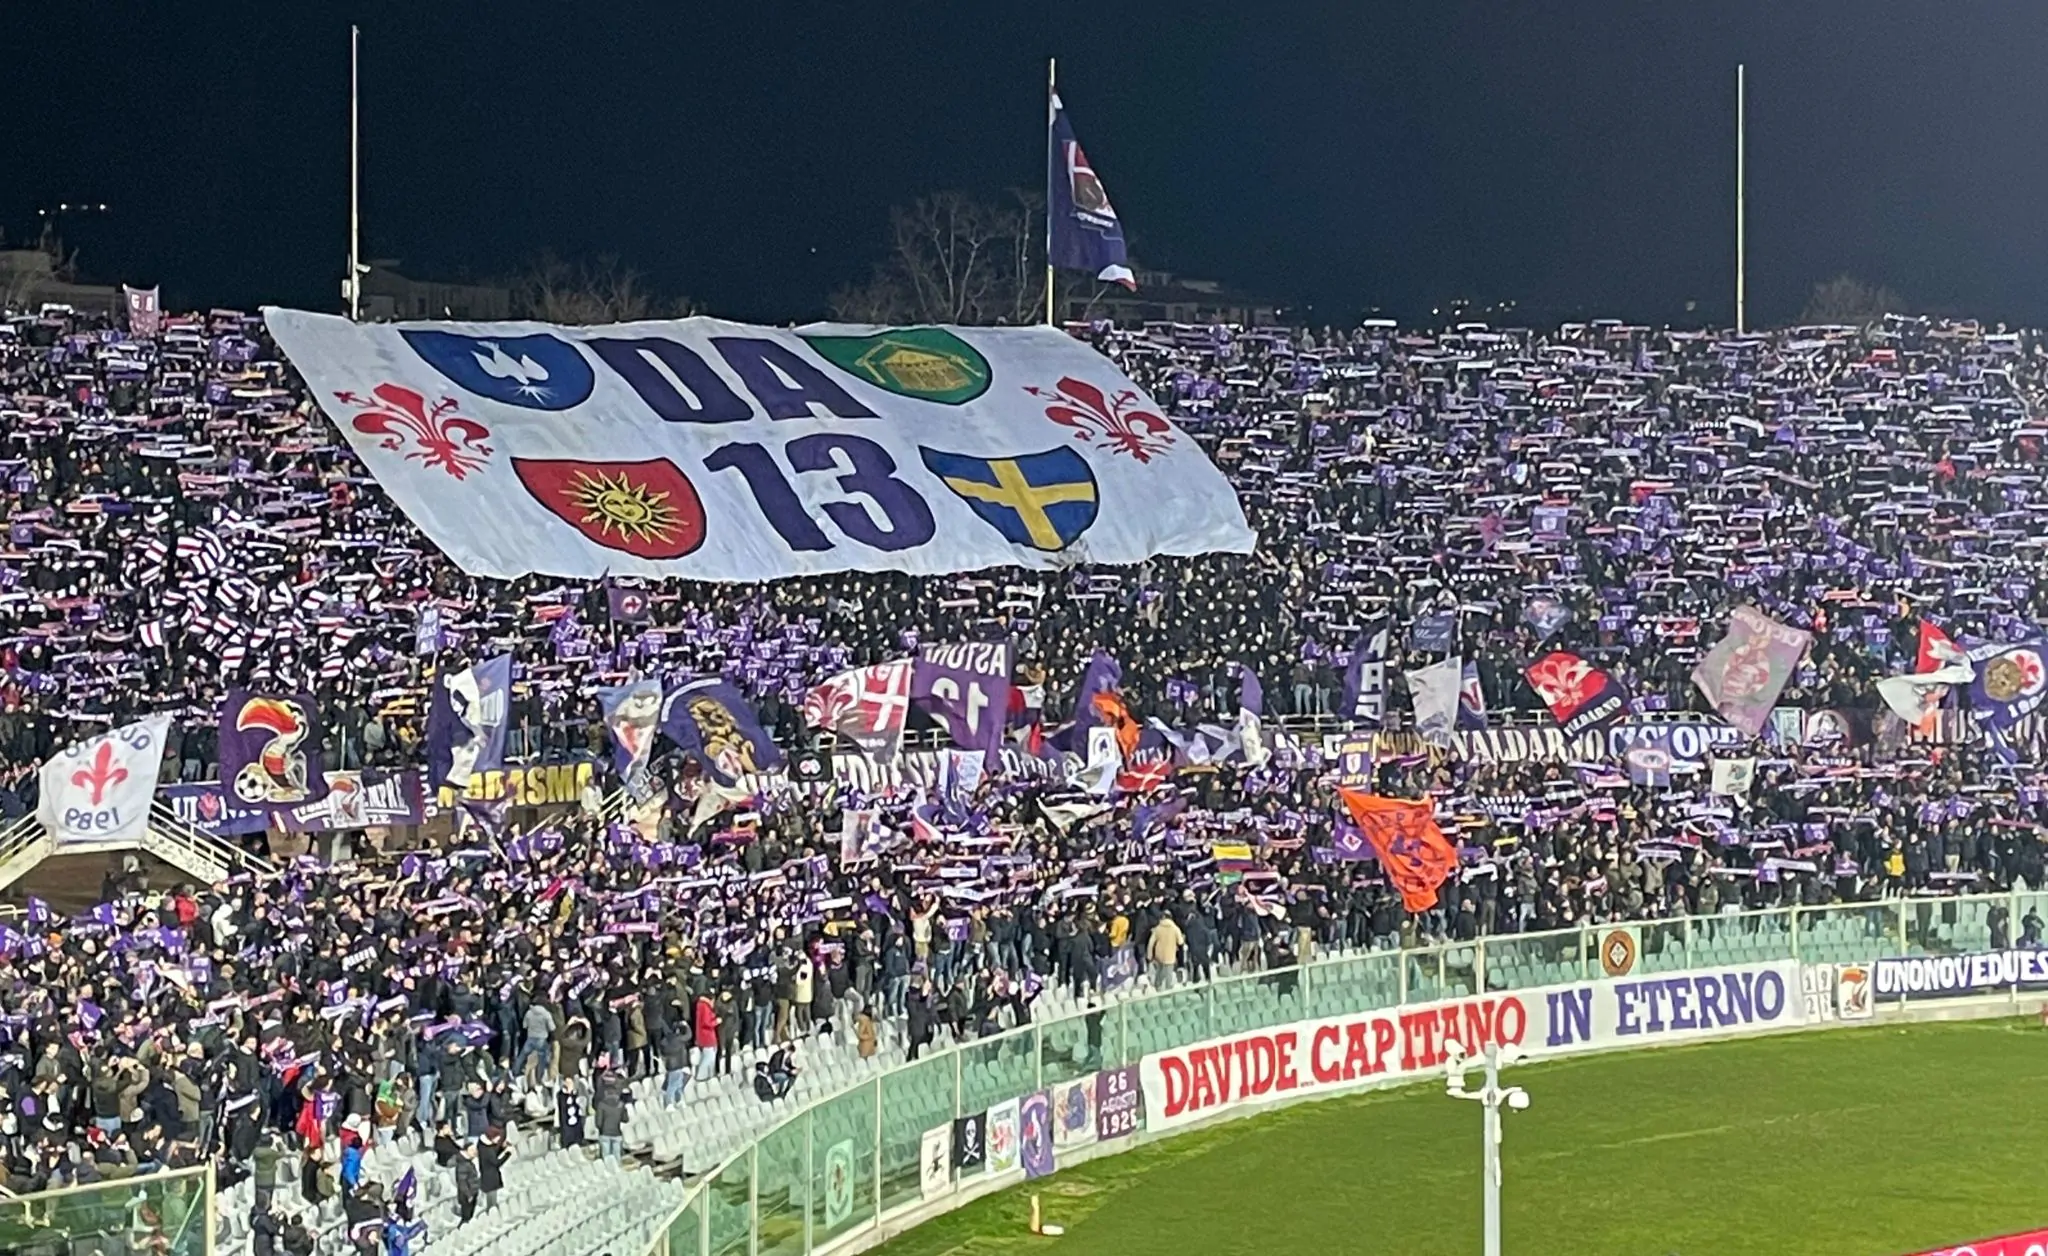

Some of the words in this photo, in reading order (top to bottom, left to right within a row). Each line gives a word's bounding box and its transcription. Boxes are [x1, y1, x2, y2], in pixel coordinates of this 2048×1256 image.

[586, 337, 882, 423] DA
[702, 433, 936, 552] 13
[1107, 1071, 1128, 1095] 26
[1159, 1032, 1298, 1118] DAVIDE
[1311, 996, 1527, 1083] CAPITANO
[1546, 987, 1592, 1047] IN
[1614, 970, 1785, 1036] ETERNO
